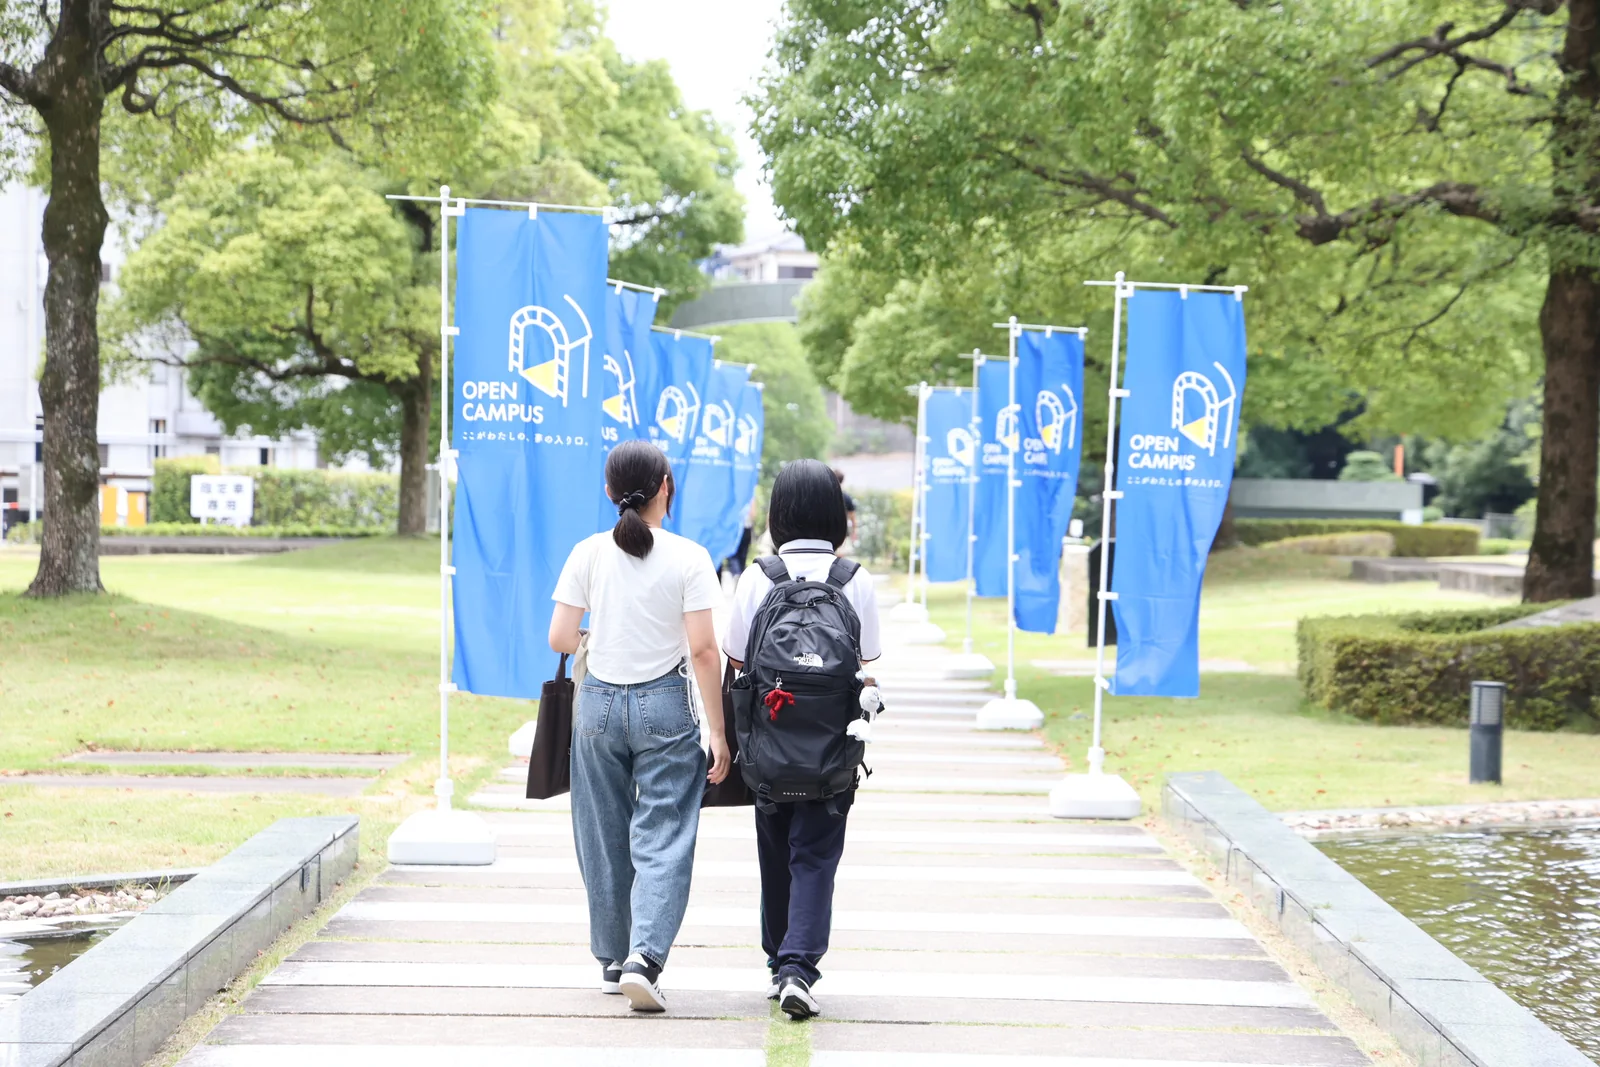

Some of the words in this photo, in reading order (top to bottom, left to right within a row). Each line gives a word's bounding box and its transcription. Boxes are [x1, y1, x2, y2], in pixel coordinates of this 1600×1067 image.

[462, 380, 518, 400] OPEN
[462, 402, 544, 424] CAMPUS
[1129, 434, 1179, 452] OPEN
[1128, 452, 1196, 471] CAMPUS
